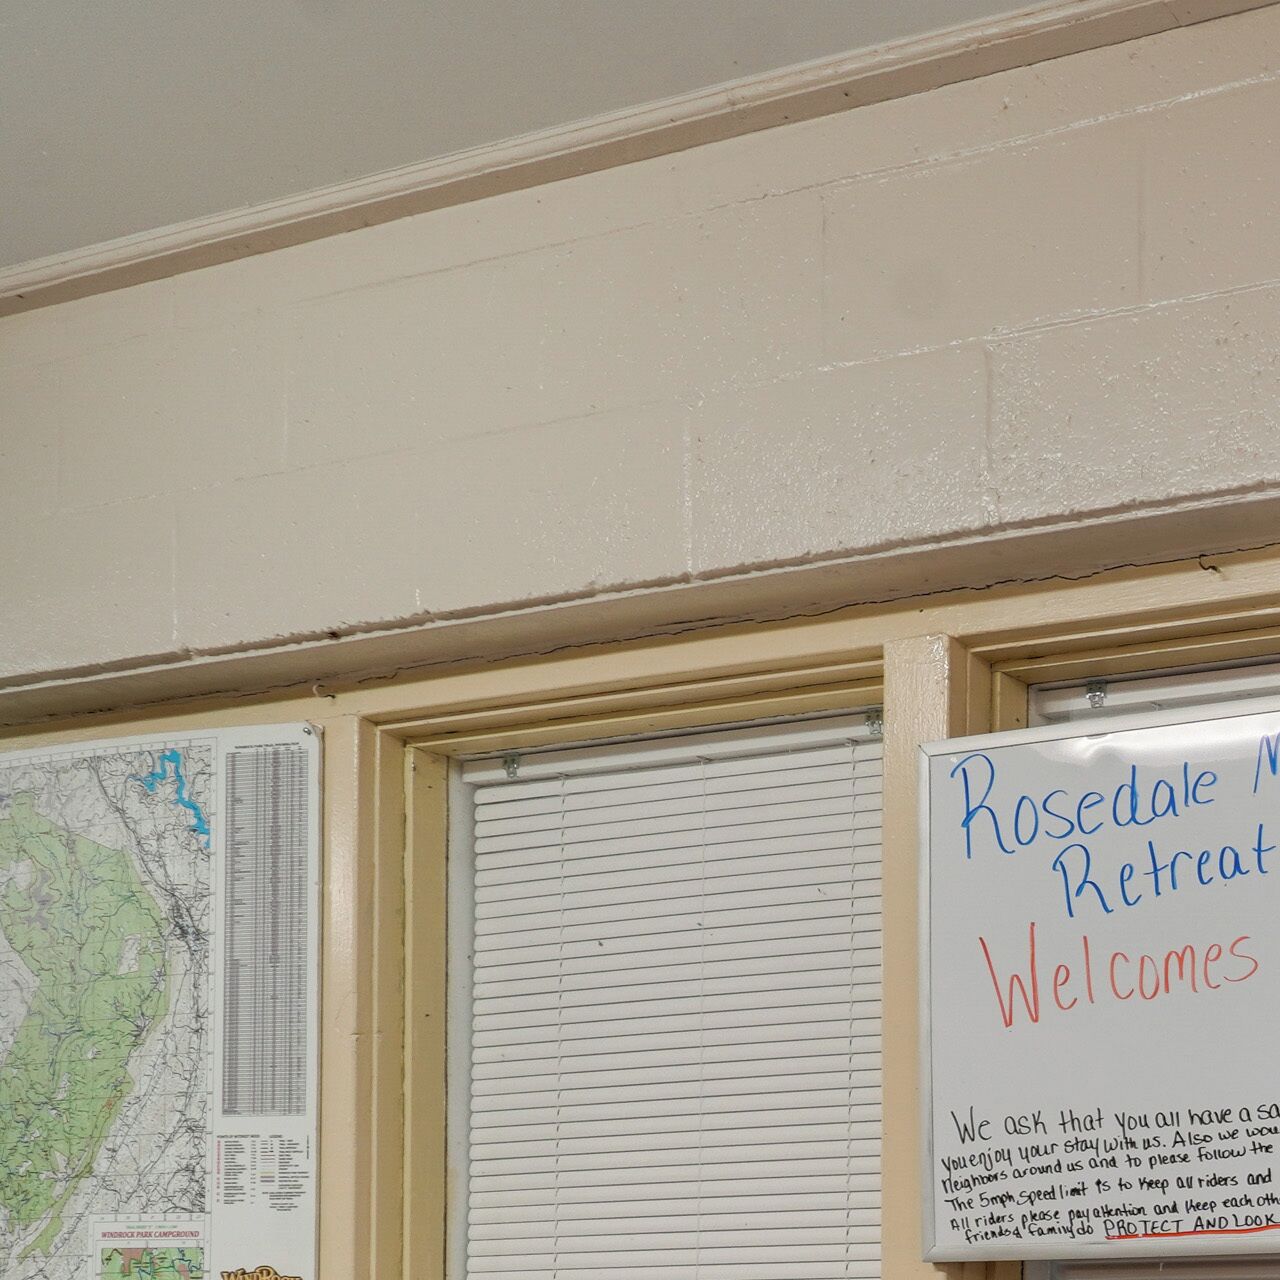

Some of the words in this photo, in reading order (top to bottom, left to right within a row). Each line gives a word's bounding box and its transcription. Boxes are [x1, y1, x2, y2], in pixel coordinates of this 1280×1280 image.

[951, 753, 1219, 859] Rosedale
[1052, 823, 1277, 917] Retreat
[979, 921, 1260, 1029] Welcomes
[951, 1106, 992, 1144] We
[1004, 1110, 1048, 1135] ask
[1058, 1108, 1104, 1134] that
[1114, 1112, 1150, 1139] you
[1155, 1111, 1181, 1128] all
[1188, 1108, 1233, 1125] have
[1239, 1107, 1252, 1123] a
[1012, 1159, 1062, 1179] around
[1067, 1160, 1084, 1172] us
[1088, 1155, 1118, 1169] and
[1125, 1155, 1142, 1168] to
[1149, 1152, 1191, 1170] please
[1249, 1141, 1273, 1155] the
[1018, 1142, 1059, 1164] your
[1064, 1137, 1099, 1157] stay
[1142, 1136, 1166, 1150] us.
[1172, 1131, 1213, 1148] Also
[1218, 1129, 1239, 1141] we
[944, 1197, 975, 1212] The
[979, 1192, 1015, 1208] 5mph
[1060, 1181, 1088, 1199] limit
[1095, 1178, 1111, 1194] is
[1118, 1177, 1133, 1190] to
[1176, 1175, 1193, 1189] all
[1198, 1173, 1238, 1188] riders
[1247, 1168, 1272, 1186] and
[950, 1216, 969, 1231] All
[974, 1211, 1015, 1228] riders
[1021, 1208, 1060, 1230] please
[1068, 1207, 1089, 1225] pay
[1092, 1203, 1147, 1218] attention
[1153, 1200, 1178, 1215] and
[1222, 1194, 1254, 1208] each
[965, 1225, 1011, 1244] friends
[1076, 1221, 1094, 1236] do
[1103, 1218, 1183, 1237] PROTECT
[1193, 1215, 1229, 1232] AND
[1232, 1213, 1277, 1228] LOOK
